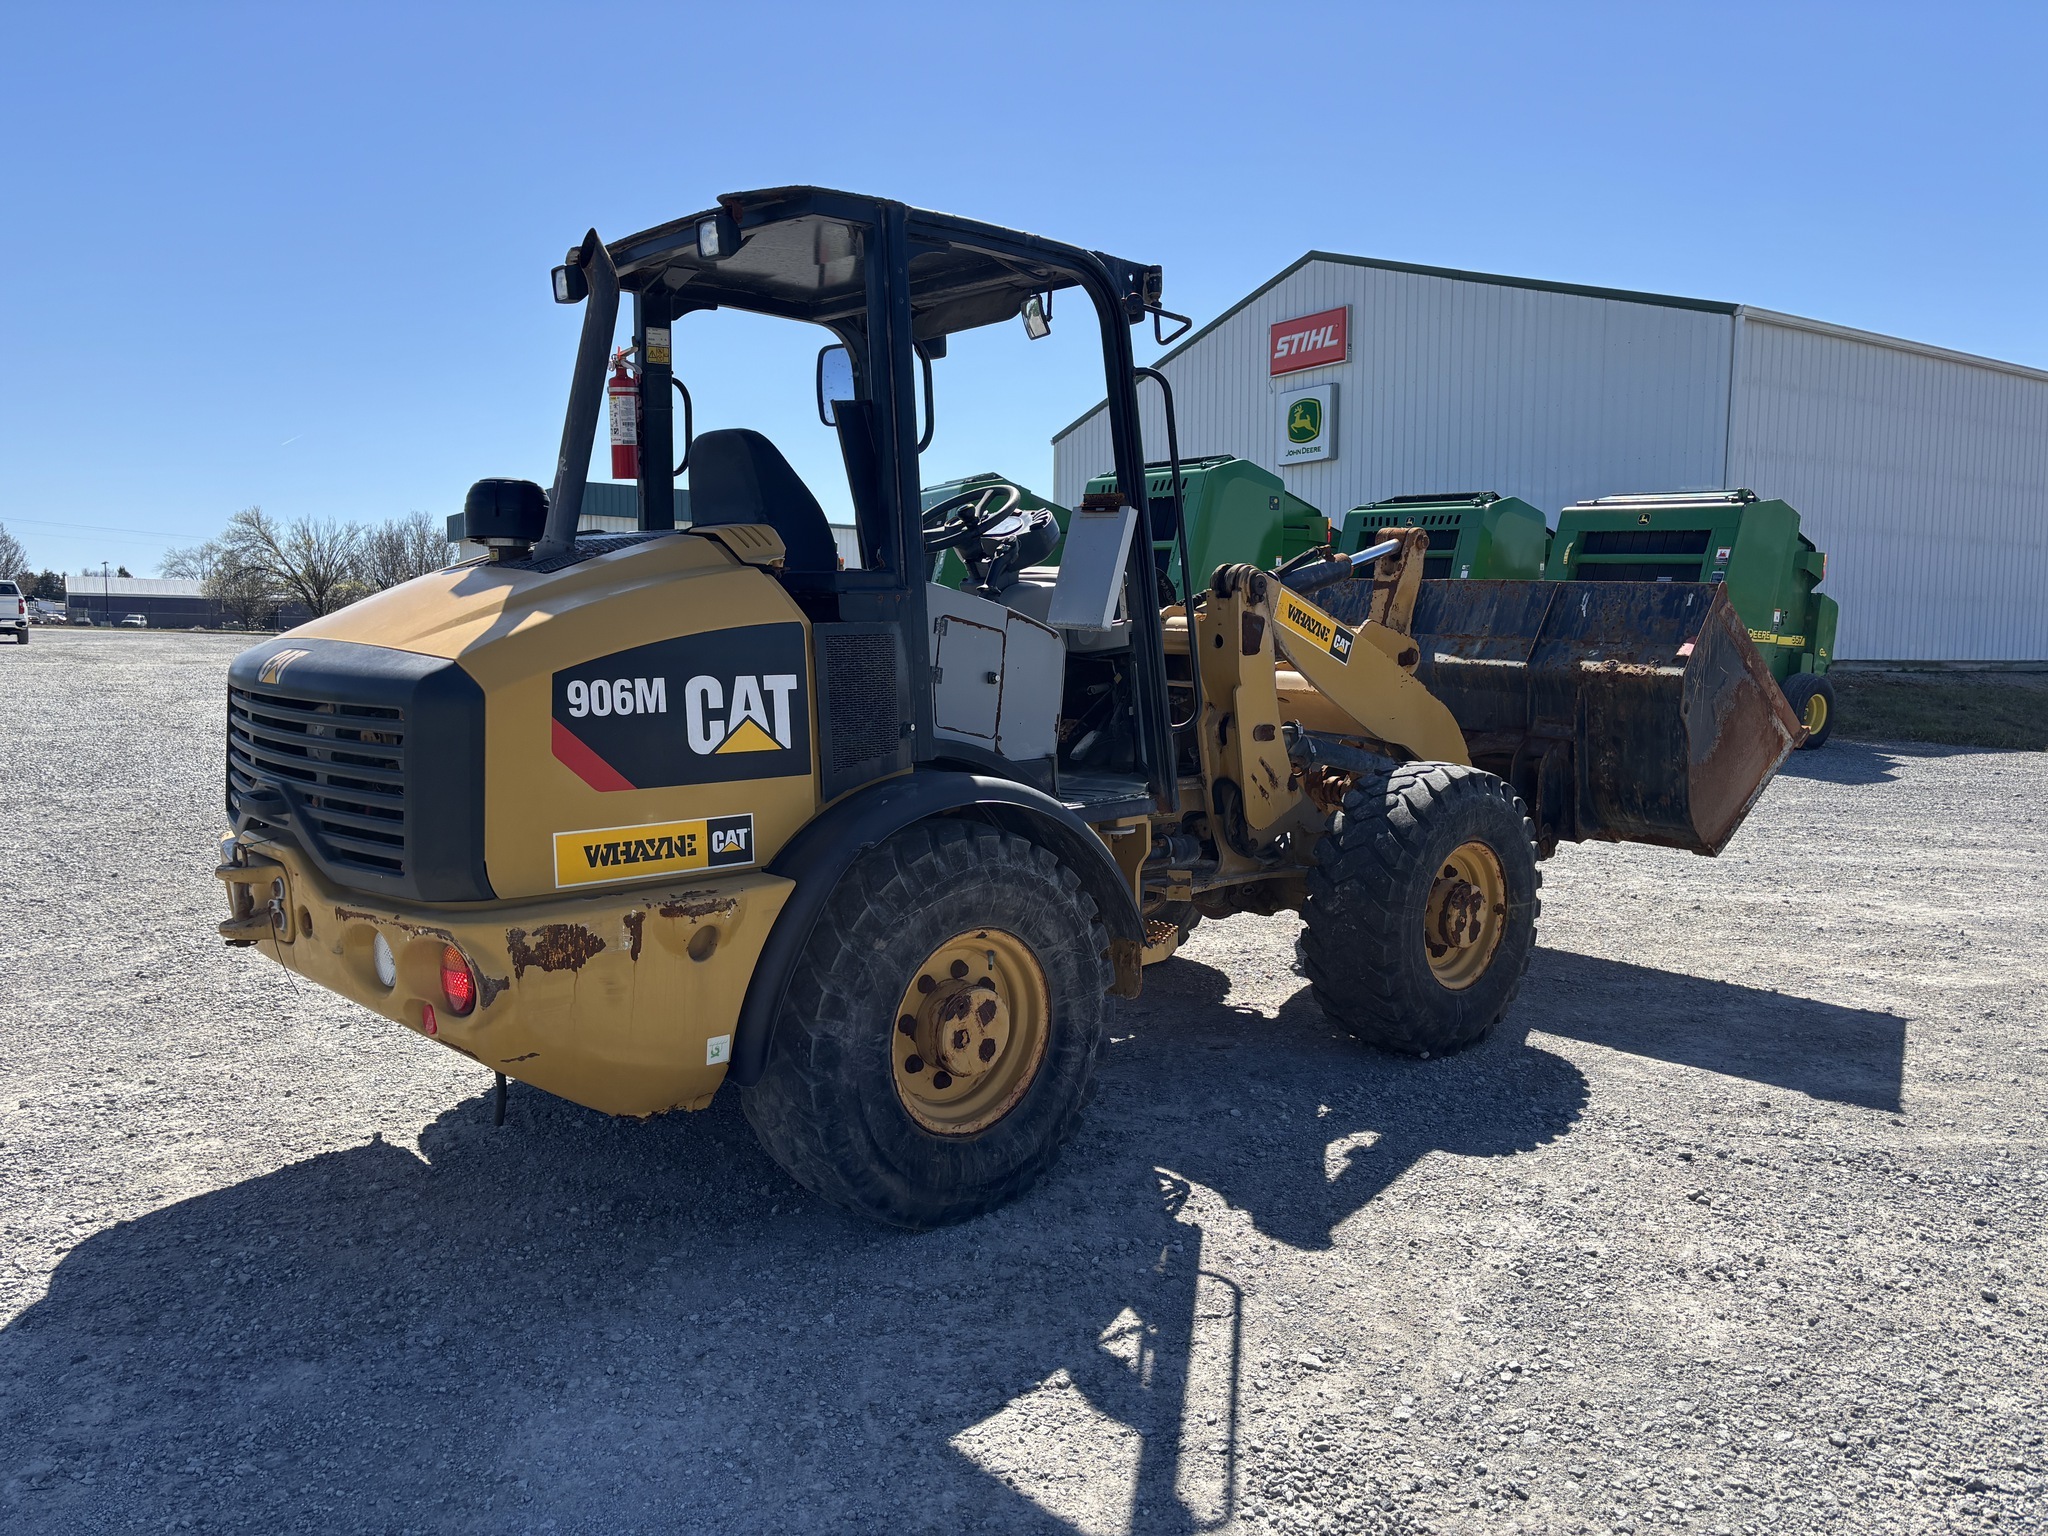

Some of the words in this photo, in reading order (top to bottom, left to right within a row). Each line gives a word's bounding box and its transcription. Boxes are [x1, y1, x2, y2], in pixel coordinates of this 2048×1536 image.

[1273, 325, 1339, 359] STIHL
[1285, 449, 1301, 457] JOHN
[1301, 446, 1321, 455] DEERE
[1288, 603, 1330, 642] WHAYNE
[1333, 634, 1351, 655] CAT
[567, 677, 667, 718] 906M
[684, 675, 797, 755] CAT
[583, 834, 697, 868] WHAYNE
[712, 828, 749, 854] CAT
